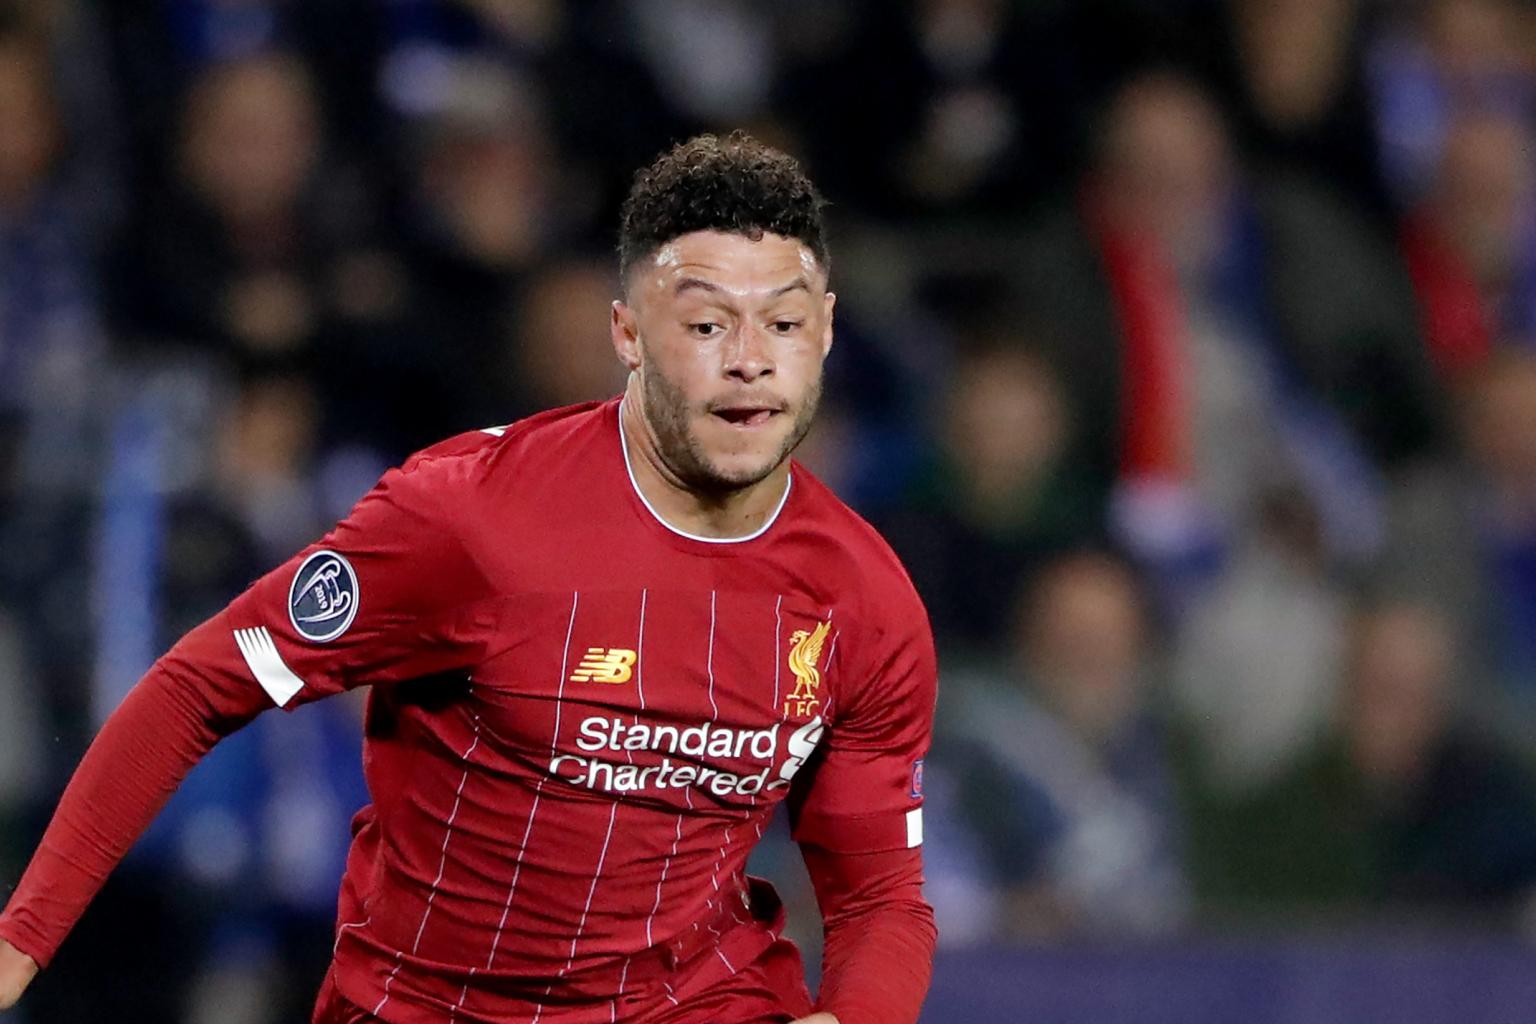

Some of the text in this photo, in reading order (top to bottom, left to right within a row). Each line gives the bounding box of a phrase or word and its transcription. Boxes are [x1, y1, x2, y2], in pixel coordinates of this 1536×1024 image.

[314, 584, 328, 610] 2019
[576, 716, 781, 760] Standard
[548, 754, 771, 796] Chartered
